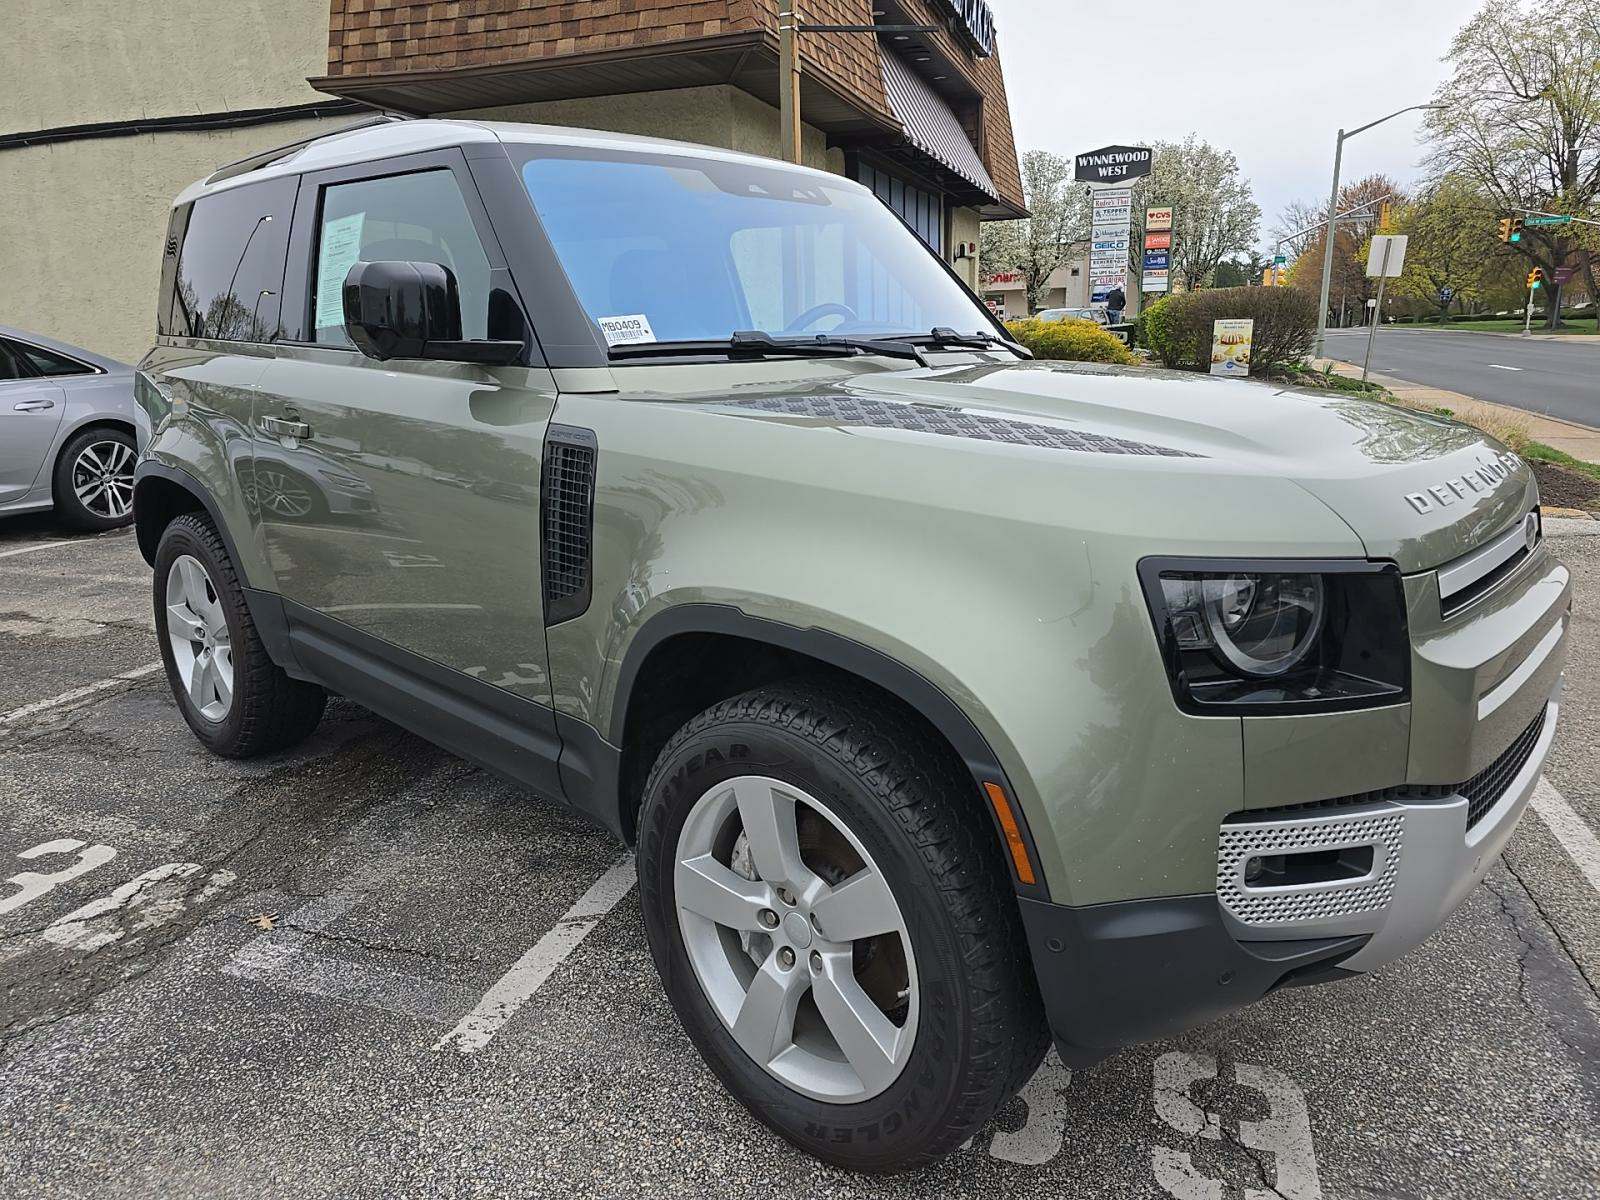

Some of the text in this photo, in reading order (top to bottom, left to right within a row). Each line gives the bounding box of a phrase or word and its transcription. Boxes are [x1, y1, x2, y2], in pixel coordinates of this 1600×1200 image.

[1078, 151, 1149, 167] WYNNEWOOD
[1098, 165, 1128, 177] WEST
[601, 320, 641, 332] MB0409
[1403, 451, 1522, 515] DEFENDER
